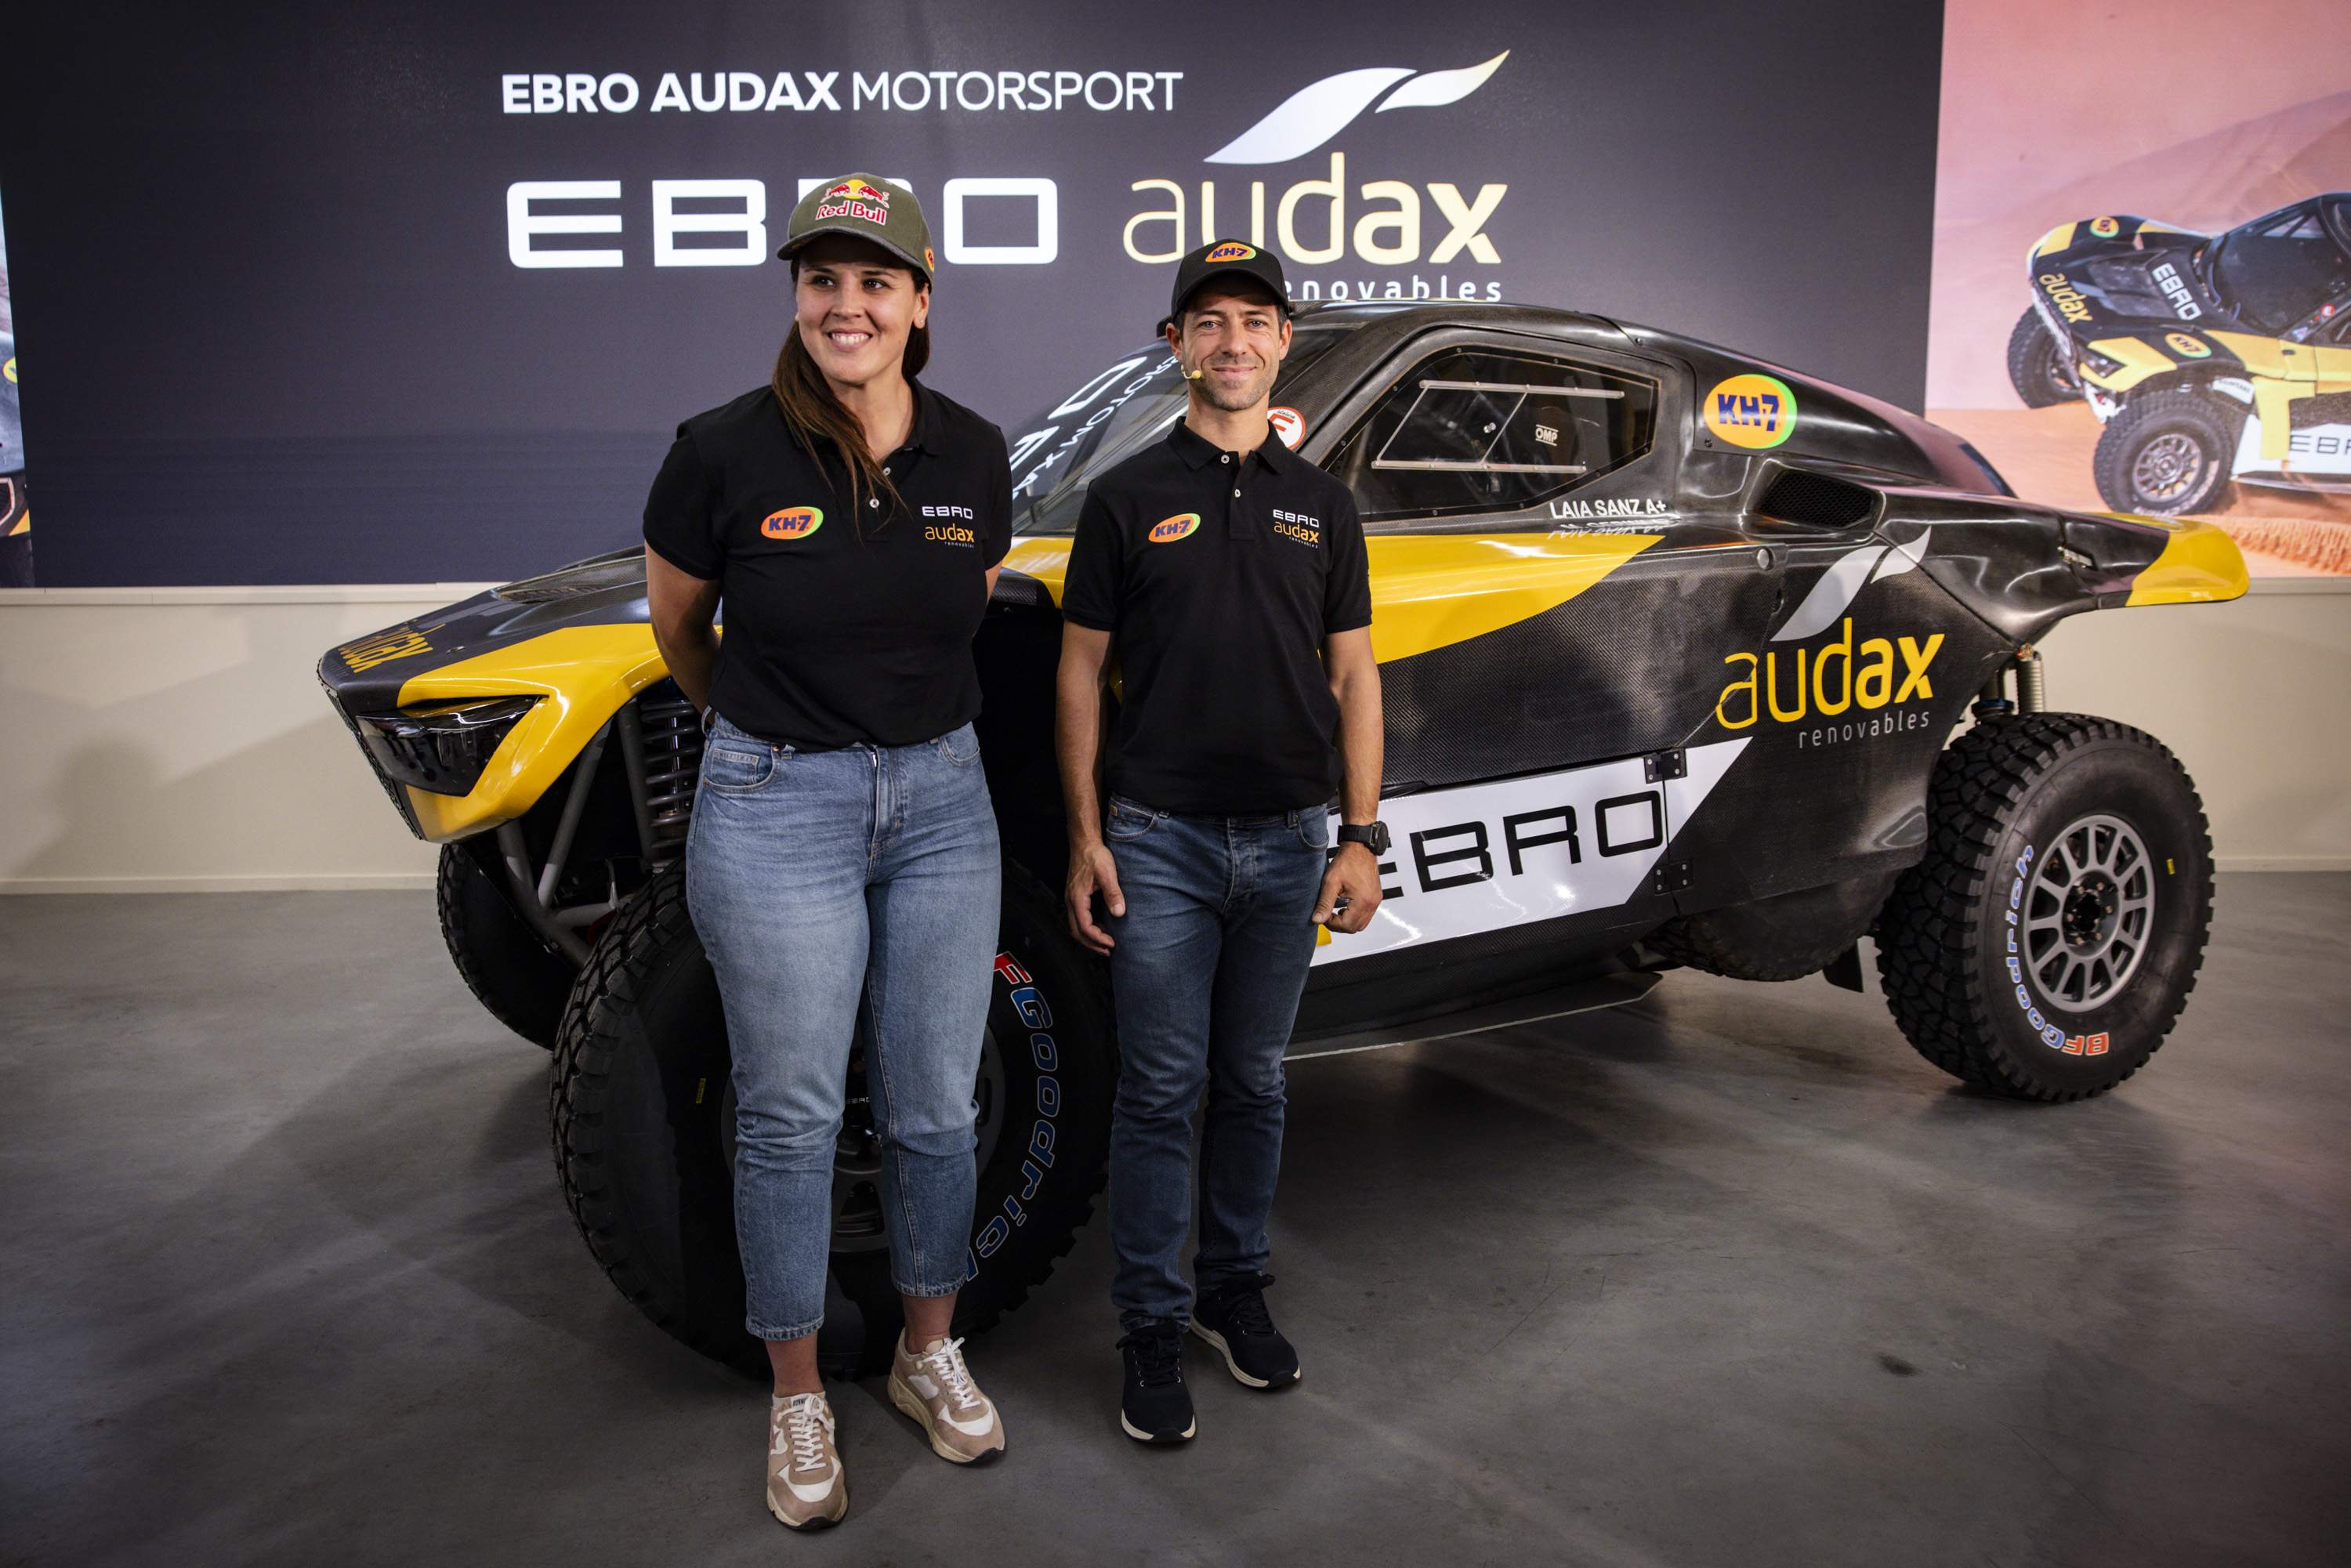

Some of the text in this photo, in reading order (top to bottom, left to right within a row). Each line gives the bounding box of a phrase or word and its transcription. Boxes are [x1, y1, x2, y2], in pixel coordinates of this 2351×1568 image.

[502, 71, 1184, 113] EBRO AUDAX MOTORSPORT
[506, 178, 1058, 267] EBO
[816, 200, 886, 225] Red Bull
[1123, 151, 1508, 265] audax
[2039, 272, 2094, 324] audax
[2152, 263, 2202, 320] EBRO
[1535, 427, 1558, 443] OMP
[922, 506, 973, 520] EBRO
[1273, 509, 1320, 528] EBRO
[1549, 498, 1666, 520] LAIA SANZ A+
[925, 523, 974, 543] audax
[1273, 521, 1319, 544] audax
[1715, 617, 1945, 730] audax
[1799, 709, 1930, 749] renovables
[1328, 791, 1663, 900] BRO
[2005, 845, 2110, 1056] BFGoodrich
[967, 950, 1060, 1280] FGoodric
